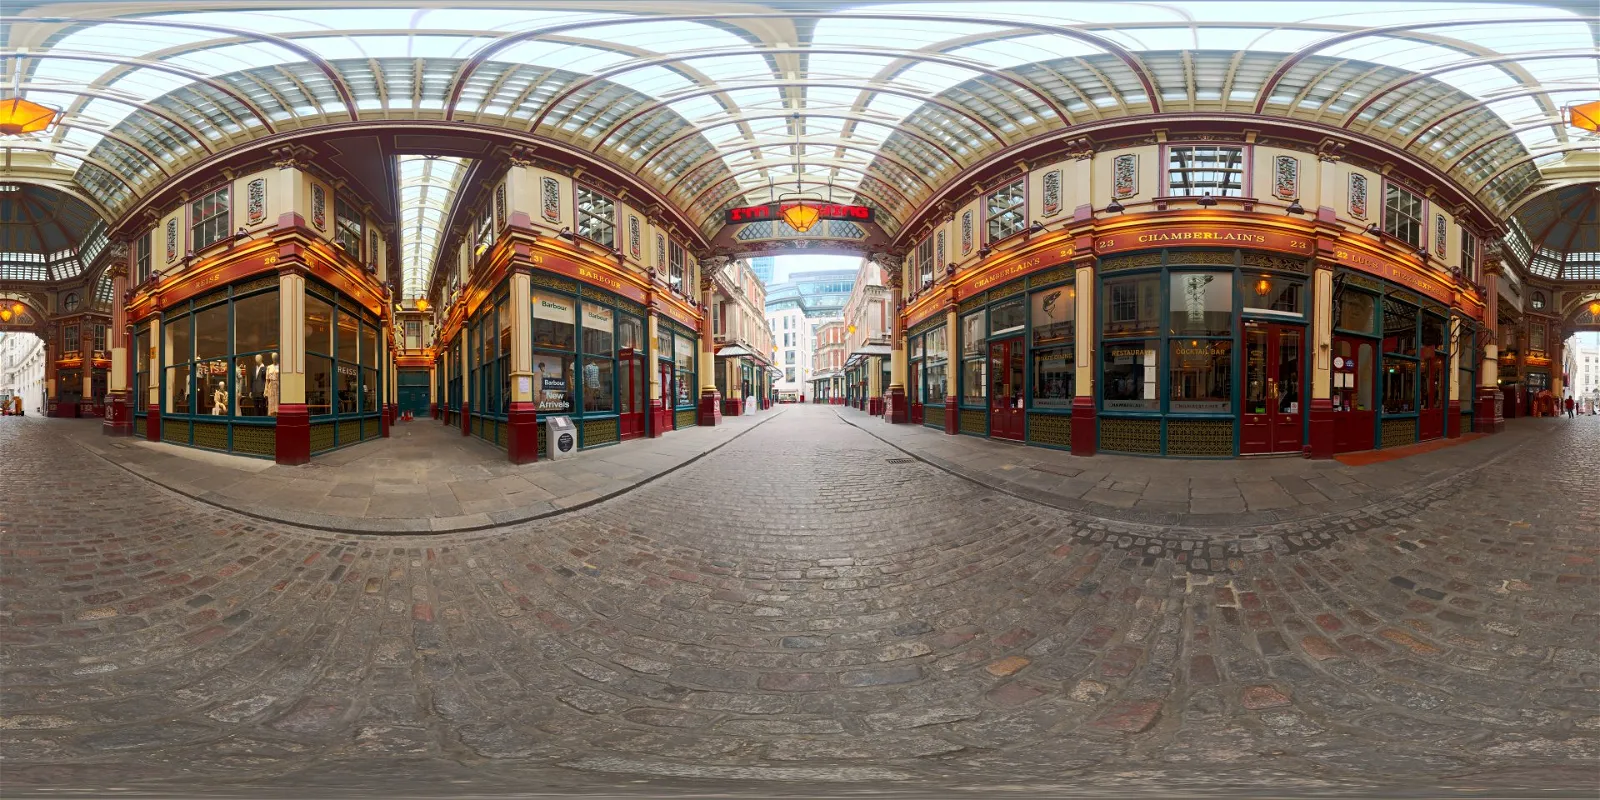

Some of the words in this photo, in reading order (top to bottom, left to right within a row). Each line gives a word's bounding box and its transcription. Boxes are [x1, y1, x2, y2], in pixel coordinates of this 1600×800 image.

[1099, 239, 1114, 249] 23
[1138, 231, 1265, 243] CHAMBERLAIN'S
[1290, 240, 1306, 249] 23
[1060, 248, 1073, 258] 24
[1336, 250, 1348, 260] 22
[264, 255, 276, 265] 26
[533, 255, 543, 263] 31
[973, 257, 1040, 289] CHAMBERLAIN'S
[194, 274, 220, 289] REISS
[579, 269, 621, 289] BARBOUR
[541, 300, 567, 311] Barbour
[588, 311, 608, 322] Barbour
[1175, 348, 1208, 356] COCKTAIL
[337, 365, 357, 376] REISS
[545, 390, 564, 400] New
[539, 401, 570, 409] Arrivals
